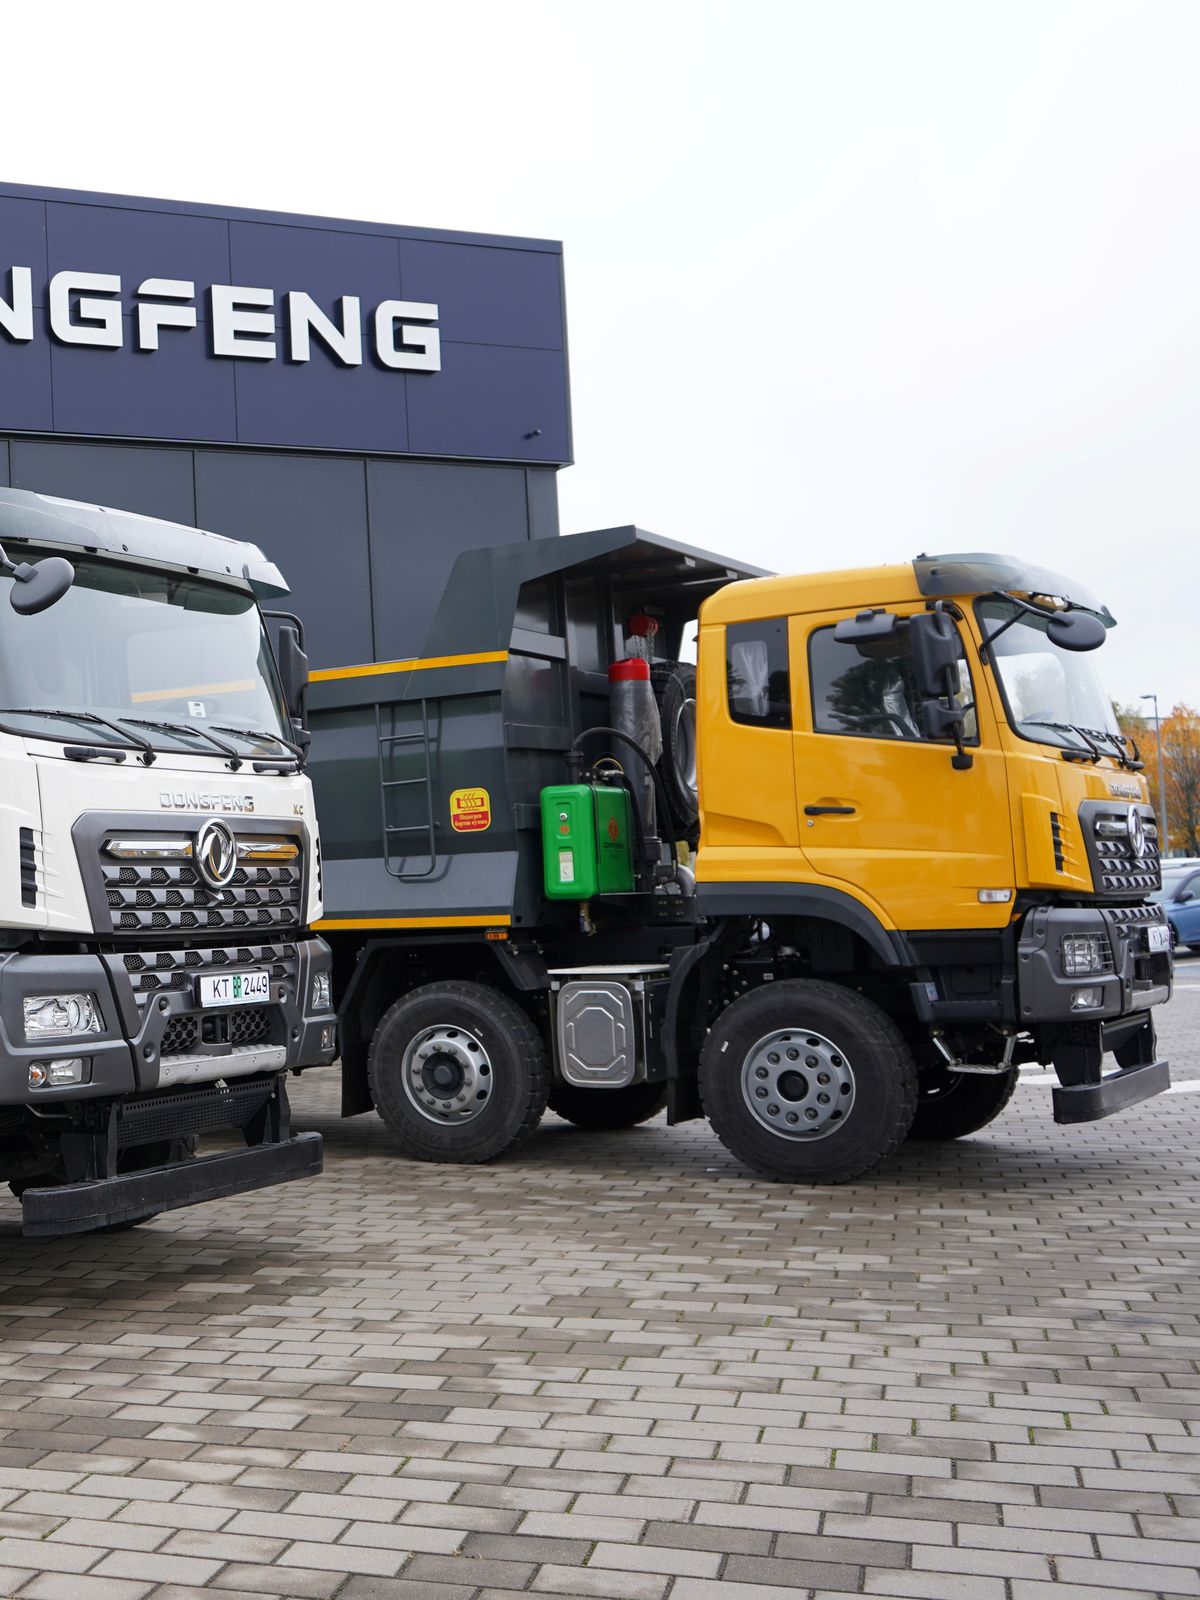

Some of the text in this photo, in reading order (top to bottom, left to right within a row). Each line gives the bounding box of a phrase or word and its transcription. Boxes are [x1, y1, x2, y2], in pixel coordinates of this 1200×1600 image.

[159, 790, 255, 812] DONGFENG
[212, 979, 231, 999] KT
[243, 975, 268, 996] 2449
